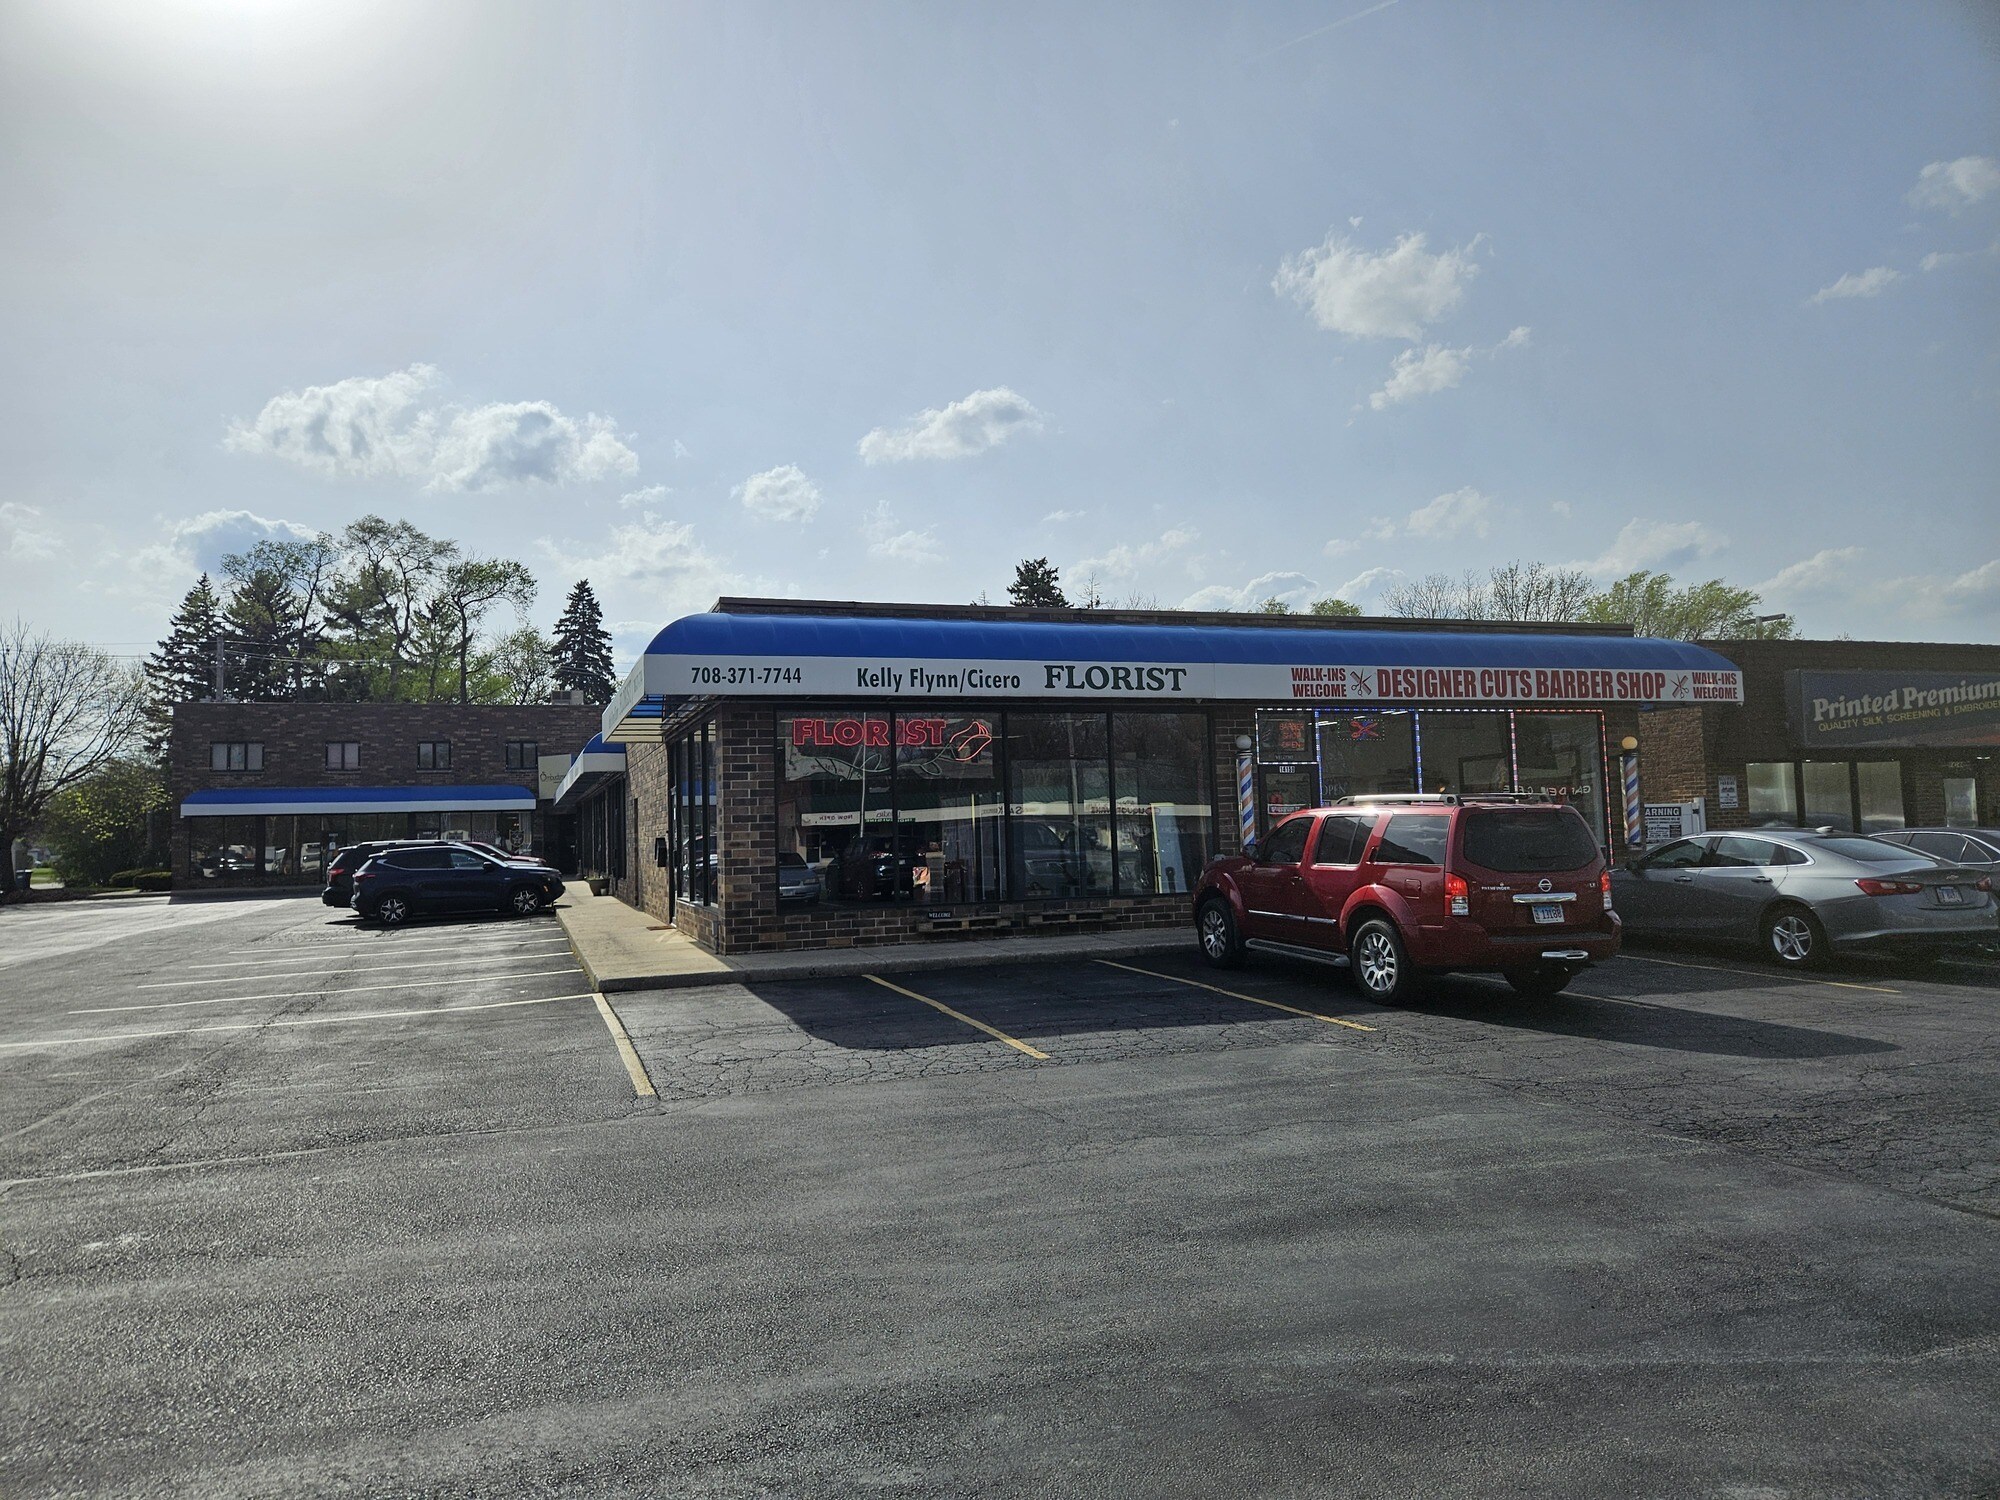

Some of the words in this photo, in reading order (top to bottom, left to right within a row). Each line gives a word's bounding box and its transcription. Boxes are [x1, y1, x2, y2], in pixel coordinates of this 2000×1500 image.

[691, 667, 802, 683] 708-371-7744
[857, 667, 902, 692] Kelly
[910, 667, 1020, 693] Flynn/Cicero
[1044, 664, 1187, 691] FLORIST
[1291, 667, 1346, 681] WALK-INS
[1377, 669, 1477, 698] DESIGNER
[1480, 669, 1532, 698] CUTS
[1535, 670, 1614, 698] BARBER
[1617, 671, 1665, 699] SHOP
[1692, 672, 1737, 685] WALK-INS
[1292, 684, 1347, 697] WELCOME
[1693, 686, 1738, 699] WELCOME
[1813, 689, 1899, 722] Printed
[1902, 680, 2000, 710] Premium
[1818, 719, 1858, 732] QUALITY
[1863, 716, 1883, 727] SILK
[1887, 708, 1941, 723] SCREENING
[1944, 706, 1951, 717] &
[1953, 700, 2000, 714] EMBROIDE
[793, 719, 947, 746] FLORIST
